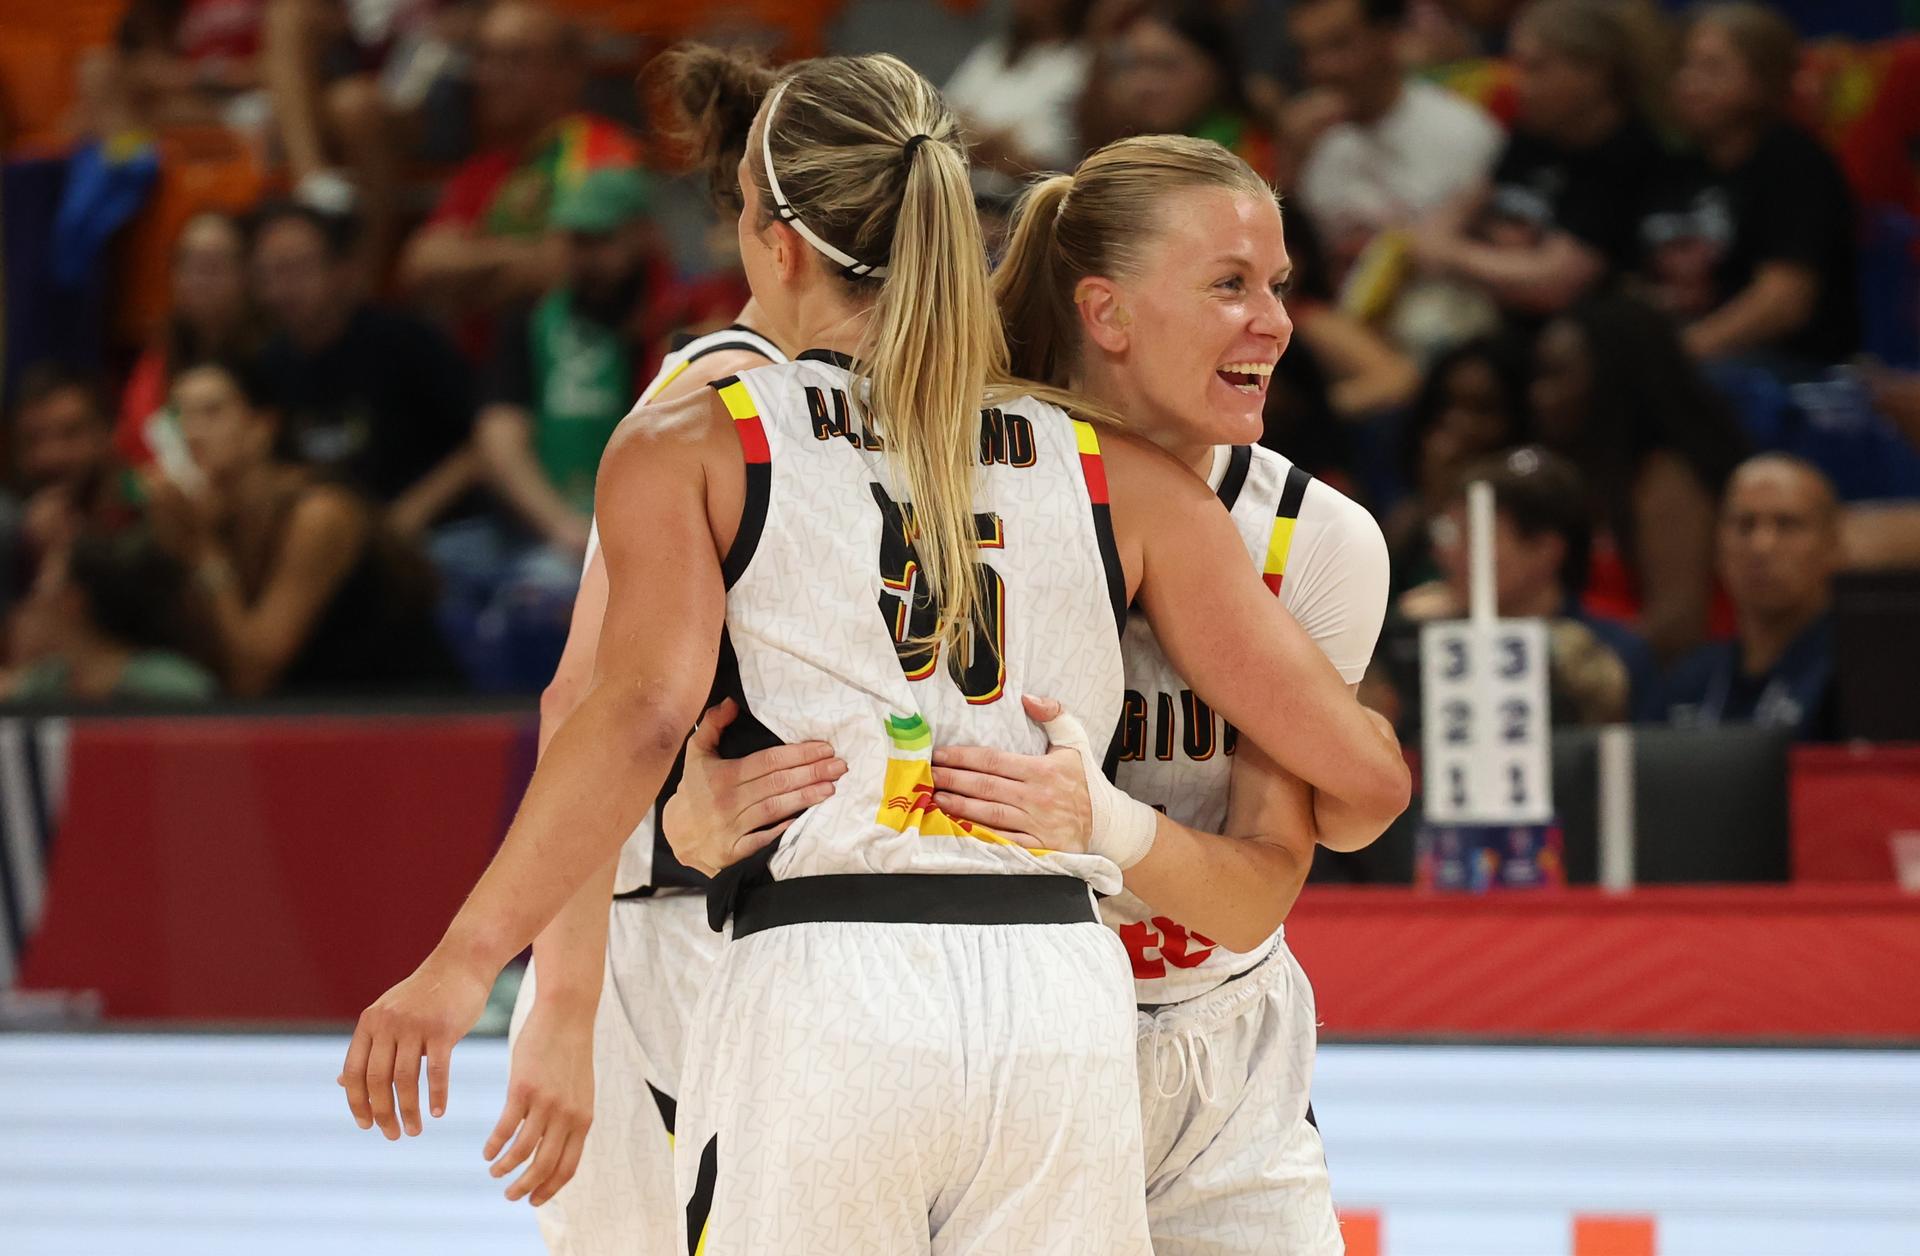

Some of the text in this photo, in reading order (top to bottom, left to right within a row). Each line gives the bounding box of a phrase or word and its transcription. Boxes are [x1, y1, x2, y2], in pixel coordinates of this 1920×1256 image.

[1441, 637, 1528, 680] 3 3
[1449, 764, 1526, 807] 1 1
